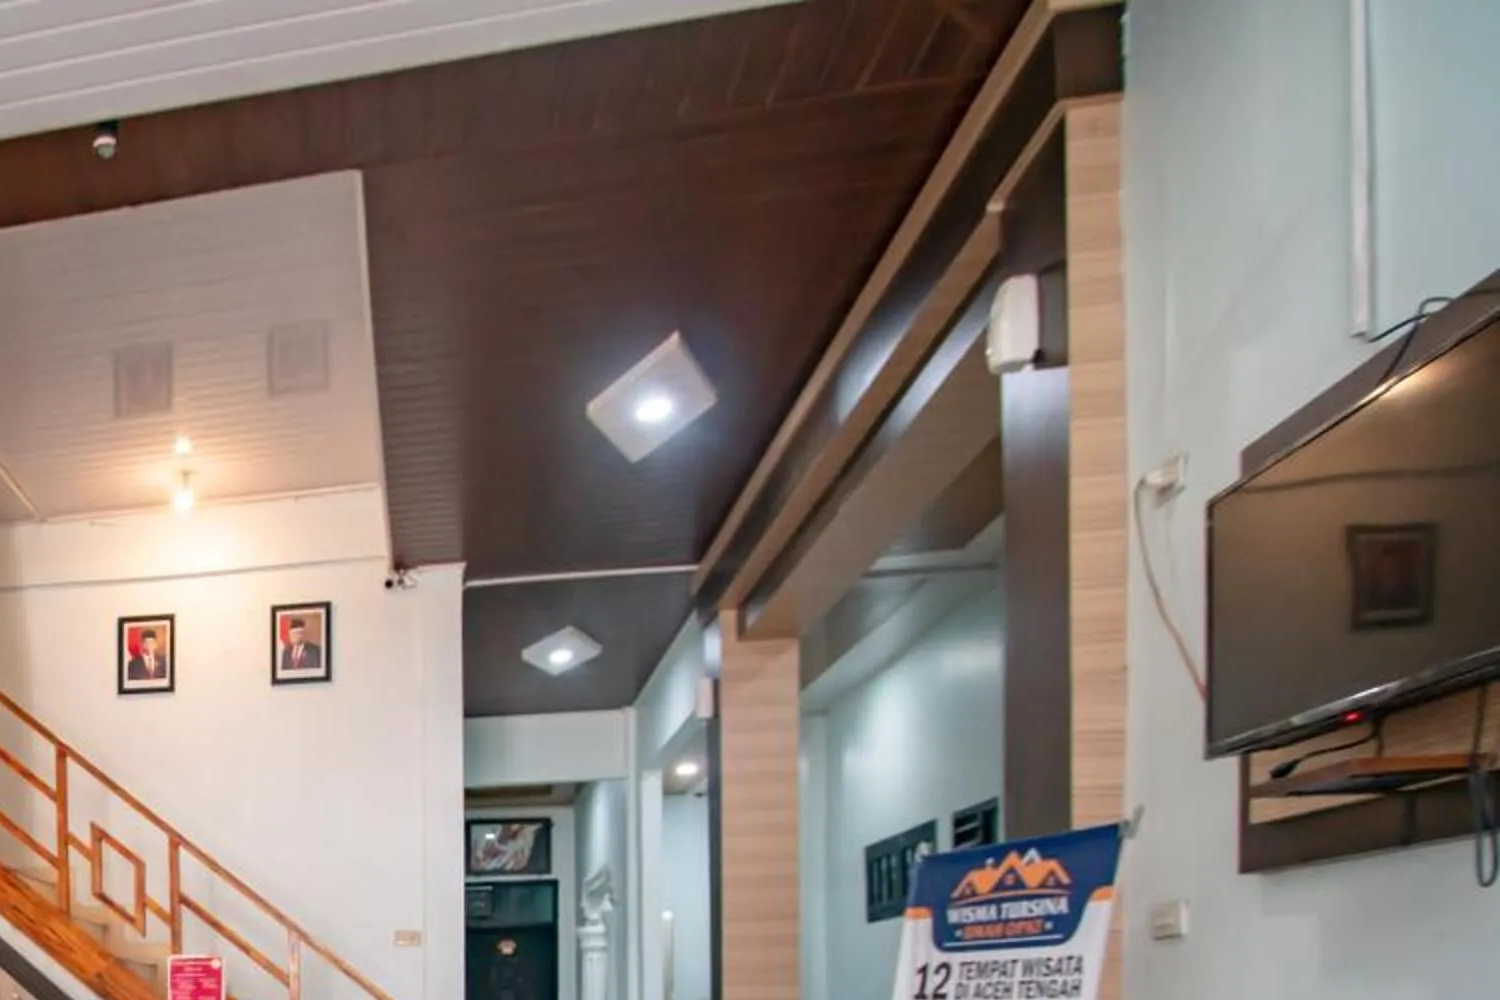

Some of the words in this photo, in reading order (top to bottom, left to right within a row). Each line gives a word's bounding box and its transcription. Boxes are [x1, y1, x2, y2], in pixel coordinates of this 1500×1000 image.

[947, 904, 998, 923] WISMA
[958, 959, 1018, 981] TEMPAT
[1022, 955, 1083, 977] WISATA
[913, 962, 952, 1000] 12
[954, 982, 969, 1000] DI
[972, 981, 1014, 1000] ACEH
[1018, 979, 1083, 999] TENGAH
